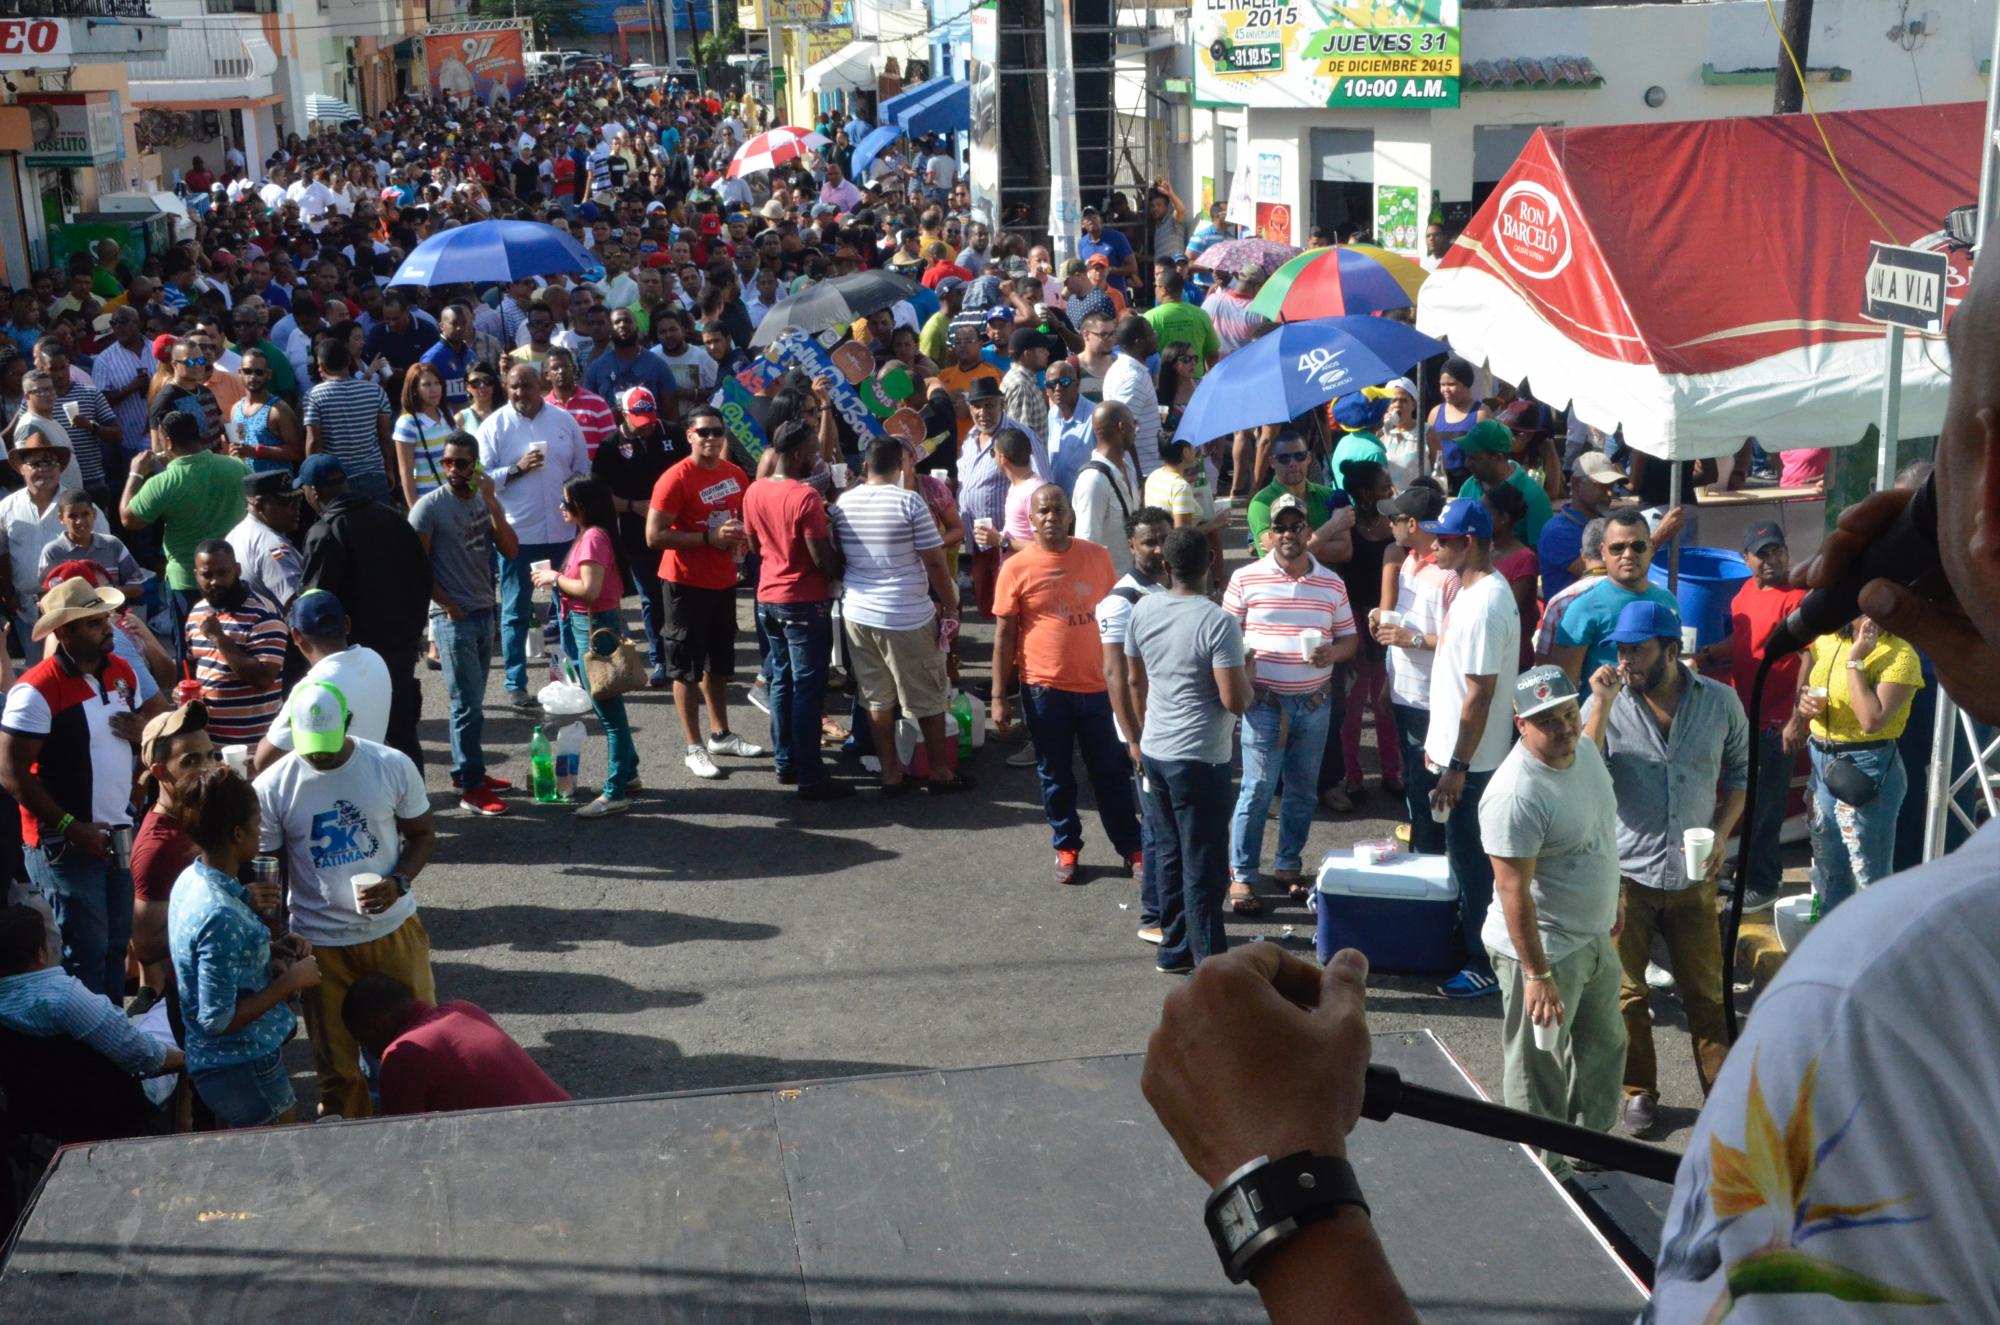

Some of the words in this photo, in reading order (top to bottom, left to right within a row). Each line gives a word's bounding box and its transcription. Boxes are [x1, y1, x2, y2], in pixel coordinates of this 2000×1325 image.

[1247, 7, 1298, 27] 2015
[1323, 33, 1411, 52] JUEVES
[1420, 32, 1447, 51] 31
[1329, 61, 1344, 72] DE
[1348, 60, 1417, 72] DICIEMBRE
[1421, 59, 1452, 72] 2015
[1344, 79, 1397, 97] 10:00
[1402, 79, 1447, 97] A.M.
[1519, 200, 1545, 227] RON
[1503, 213, 1558, 254] BARCELÓ
[871, 380, 897, 408] 2015
[662, 440, 674, 451] H
[1517, 671, 1561, 690] CHAMPIONS
[310, 810, 359, 857] 5K
[313, 850, 365, 869] FATIMA
